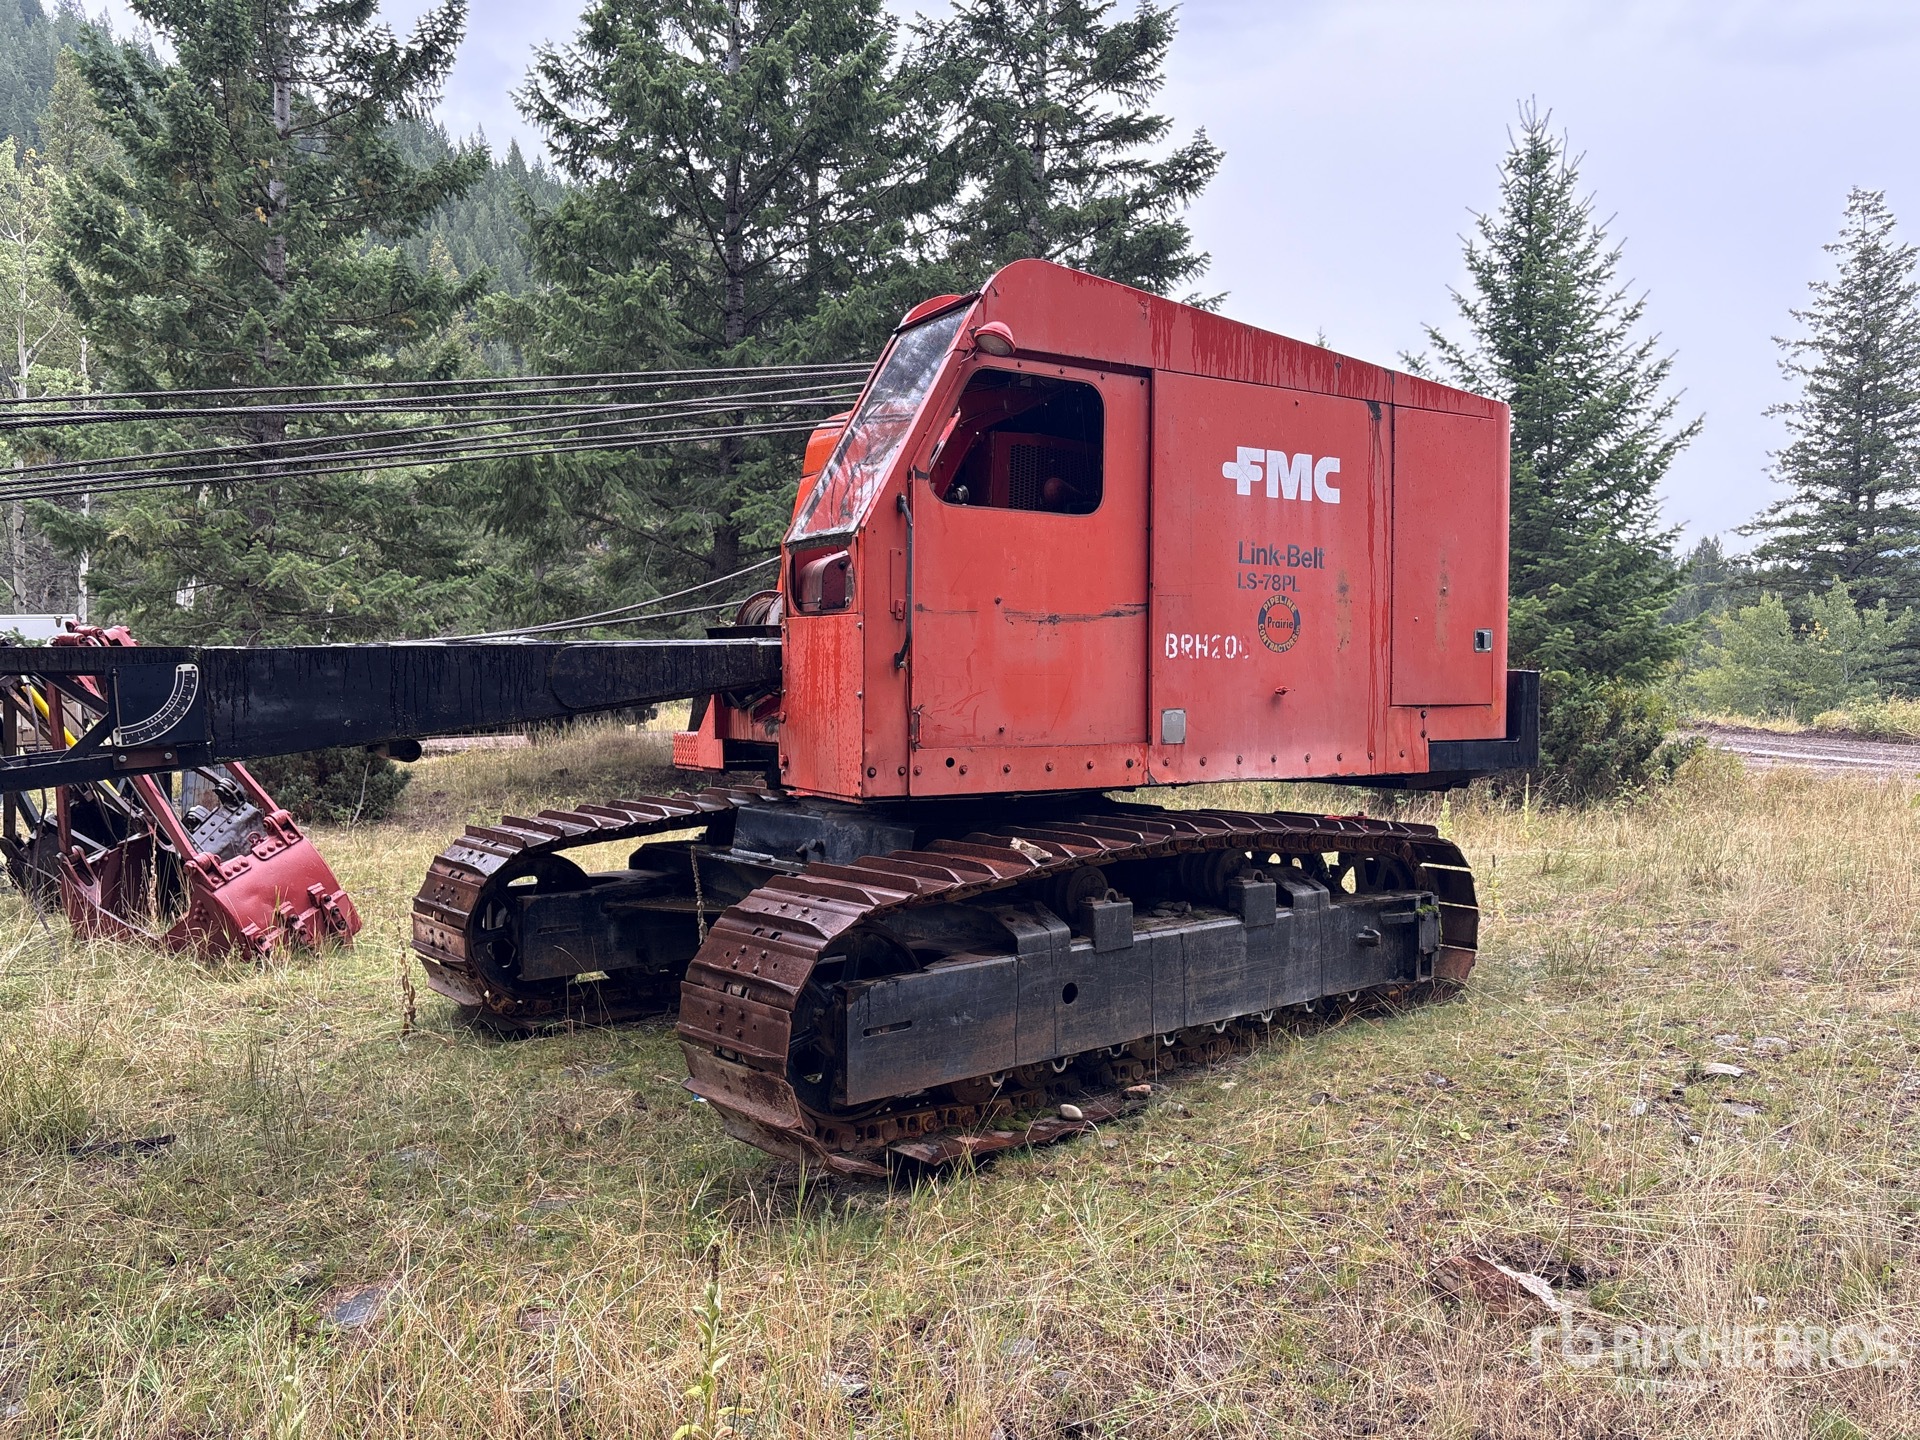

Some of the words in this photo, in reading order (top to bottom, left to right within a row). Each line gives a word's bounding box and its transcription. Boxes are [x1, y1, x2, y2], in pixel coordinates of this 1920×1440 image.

[1222, 446, 1341, 504] FMC
[1238, 540, 1326, 570] Link-Belt
[1237, 571, 1301, 593] LS-78PL
[1263, 595, 1297, 613] PIPELINE
[1267, 616, 1294, 629] Prairie
[1258, 623, 1298, 652] CONTRACTORS
